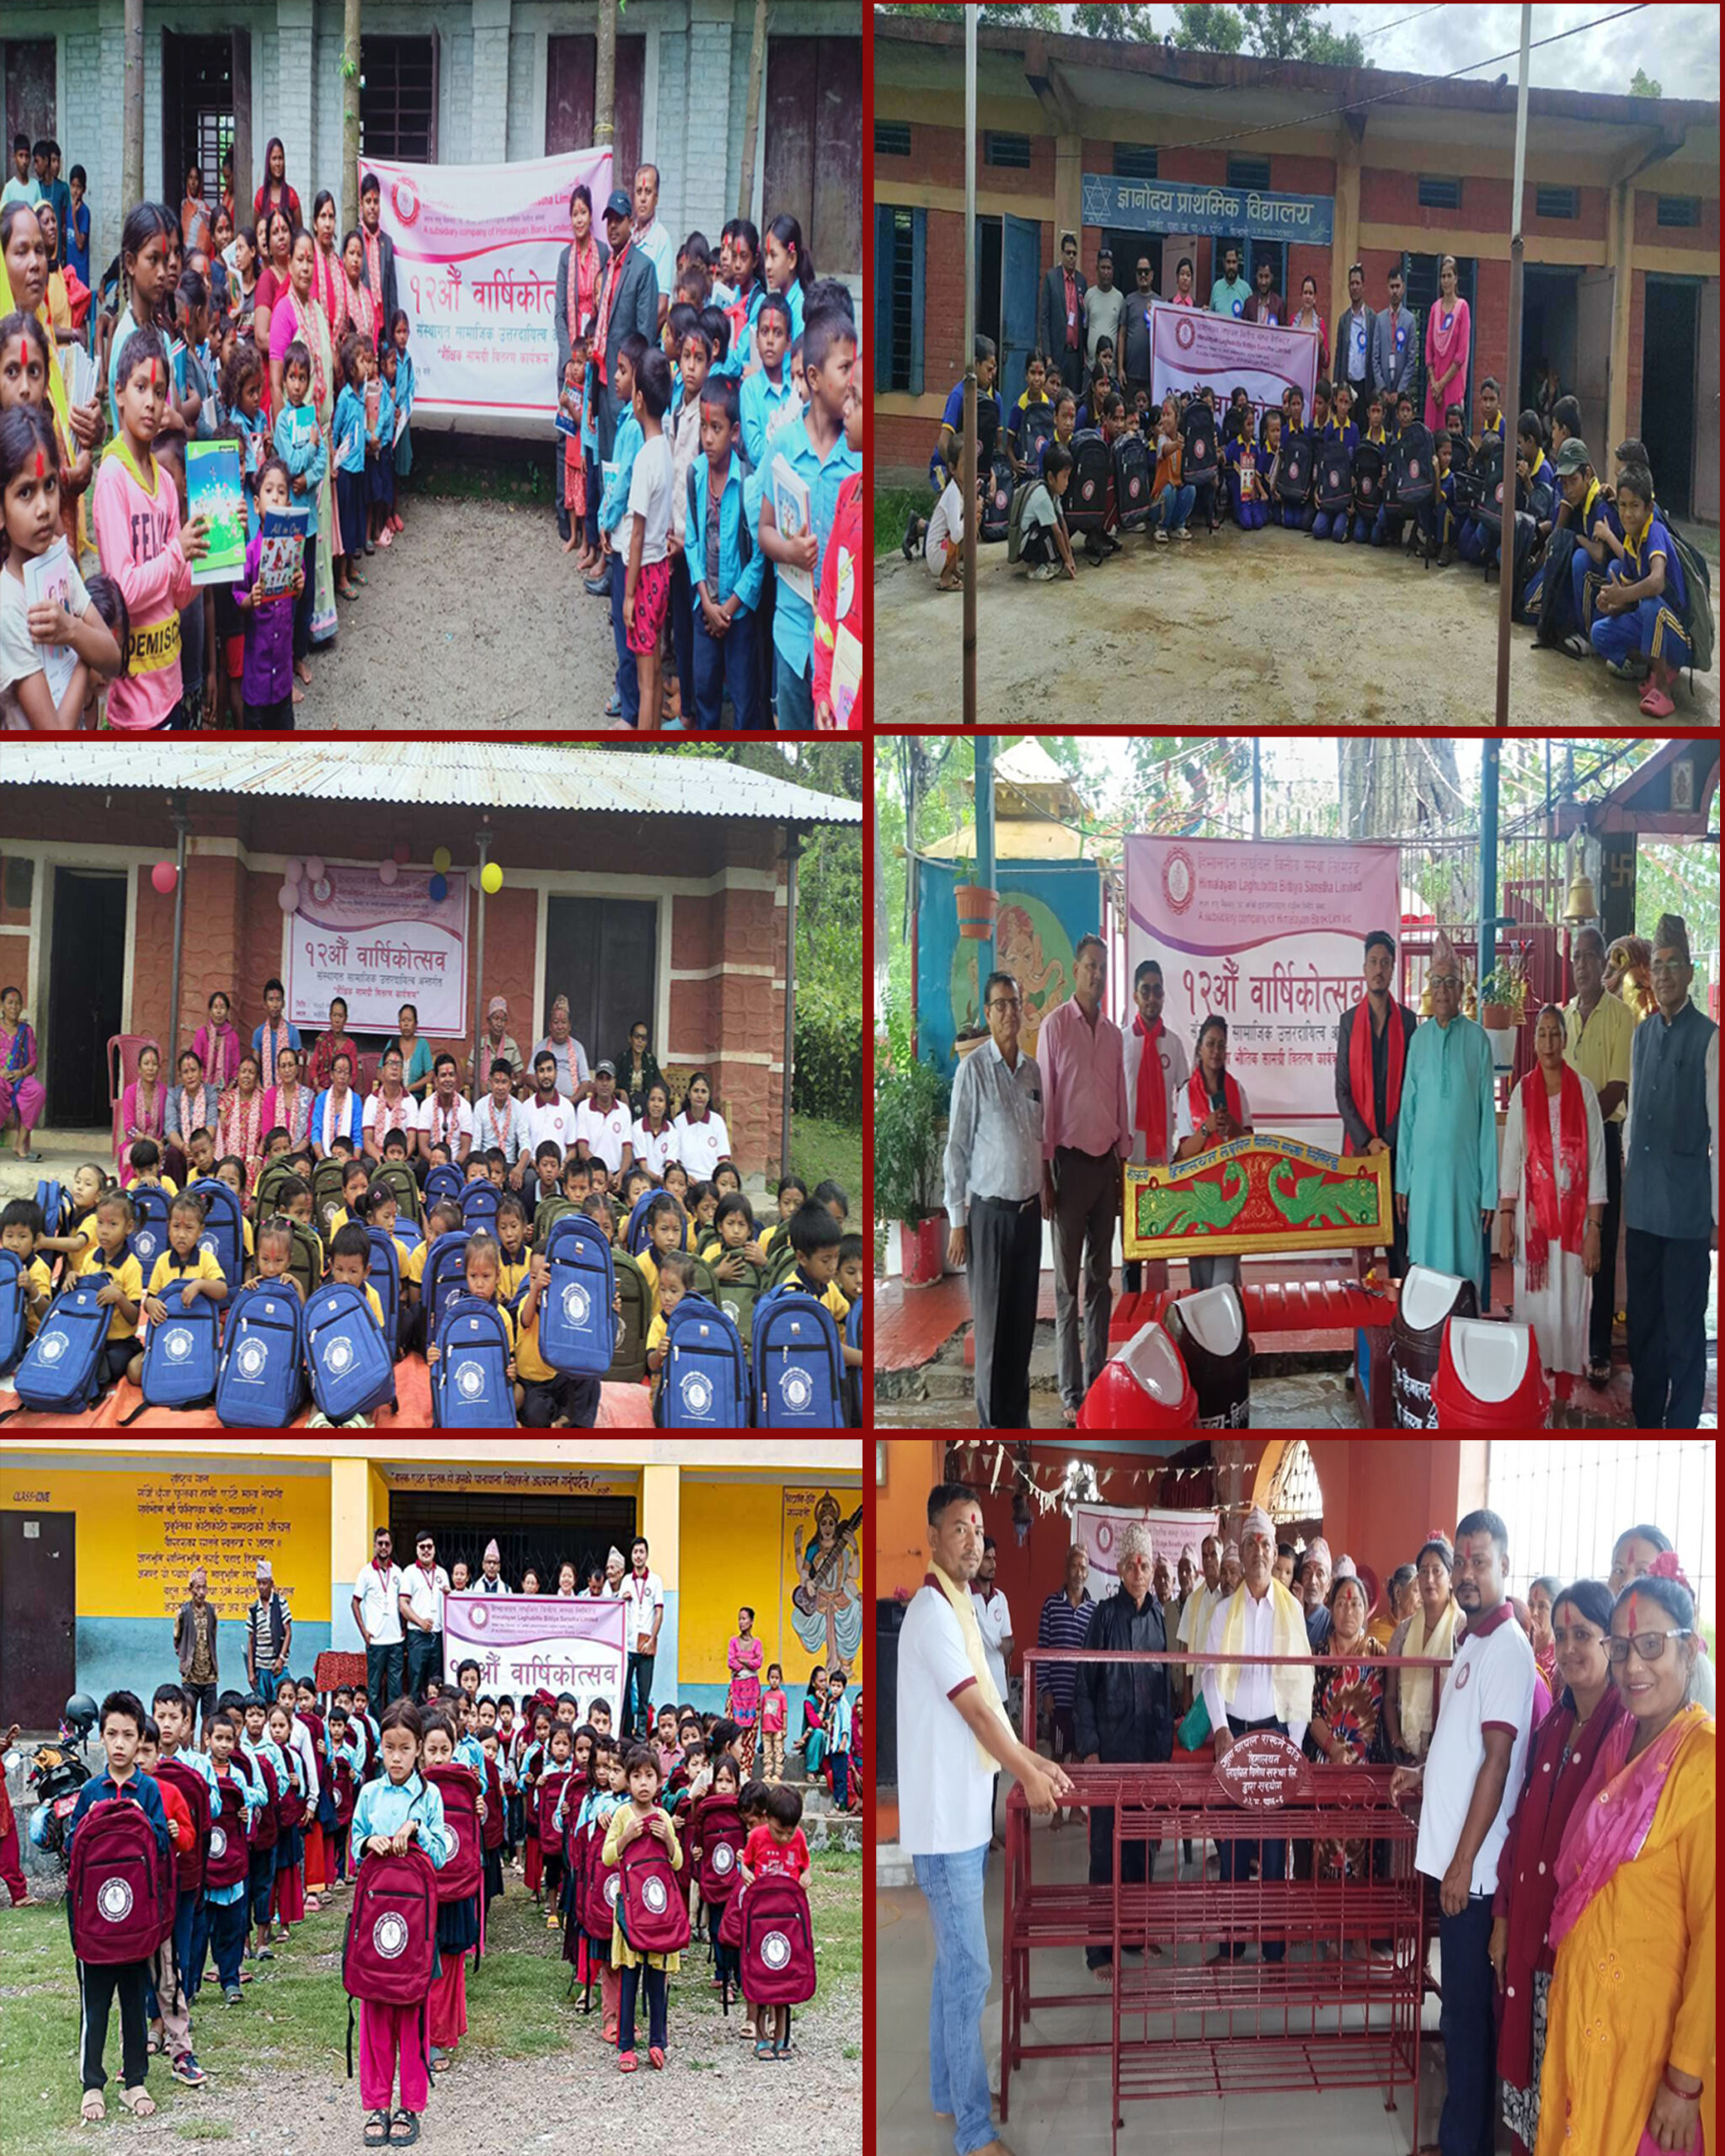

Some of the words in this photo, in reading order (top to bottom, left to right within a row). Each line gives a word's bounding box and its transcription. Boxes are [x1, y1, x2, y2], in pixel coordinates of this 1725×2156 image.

[1118, 182, 1175, 212] ज्ञानोदय
[1177, 189, 1240, 218] प्राथमिक
[1245, 193, 1315, 225] विद्यालय
[1198, 878, 1237, 893] Himalayan
[356, 940, 448, 972] वार्षिकोत्सव
[510, 1654, 619, 1686] वार्षिकोत्सव
